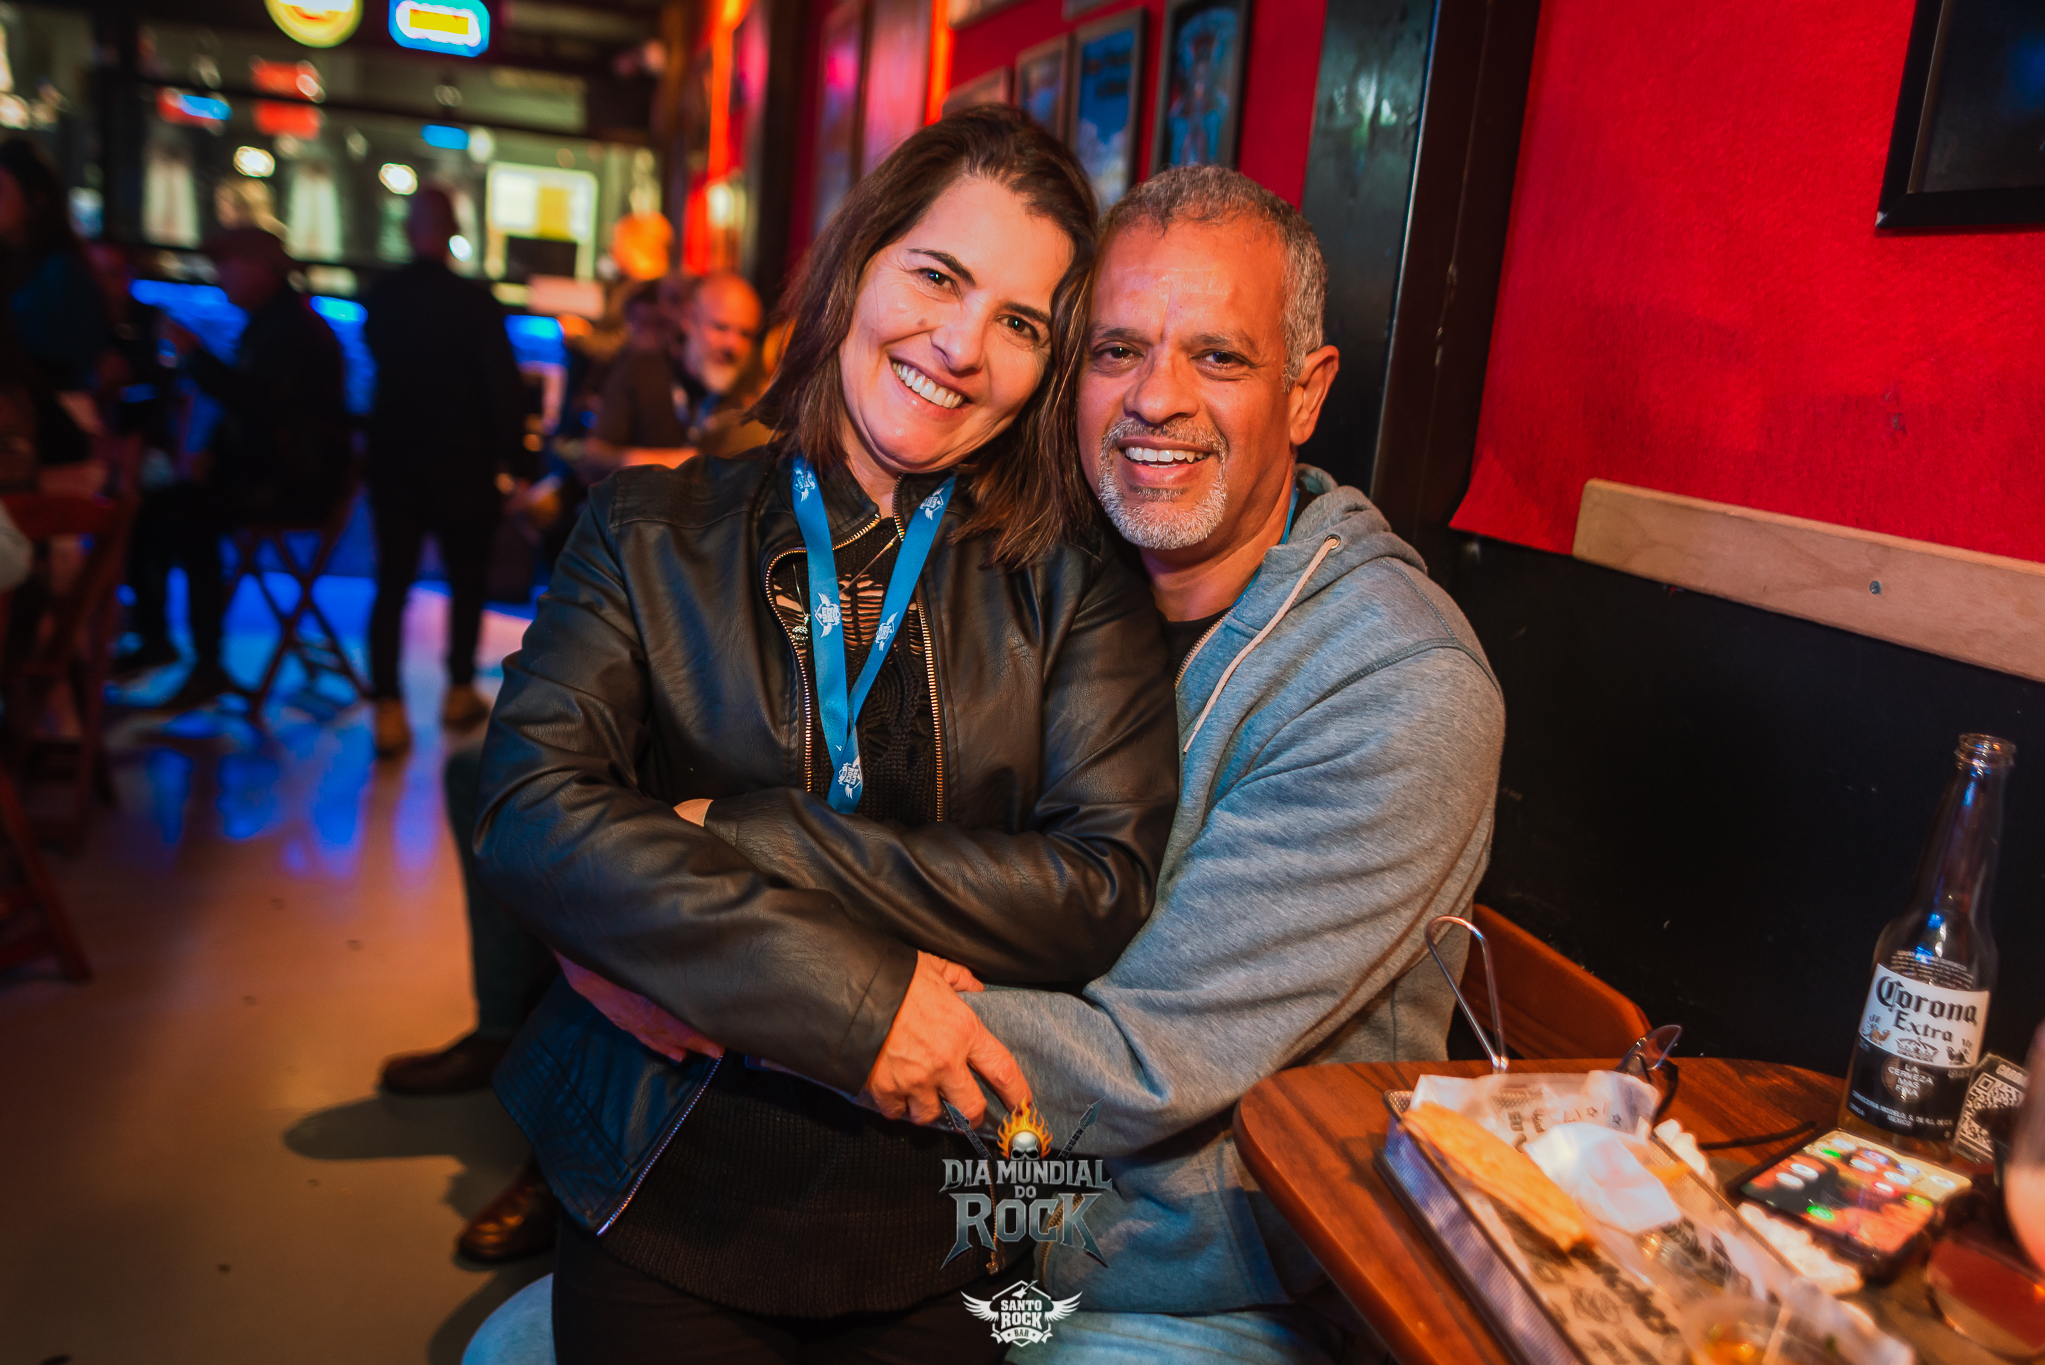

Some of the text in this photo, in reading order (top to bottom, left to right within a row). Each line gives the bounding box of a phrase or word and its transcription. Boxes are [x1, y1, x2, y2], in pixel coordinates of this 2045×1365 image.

[1876, 976, 1978, 1026] Corona
[1893, 1009, 1953, 1042] Extra
[1888, 1066, 1934, 1086] CERVEZA
[1904, 1063, 1919, 1074] LA
